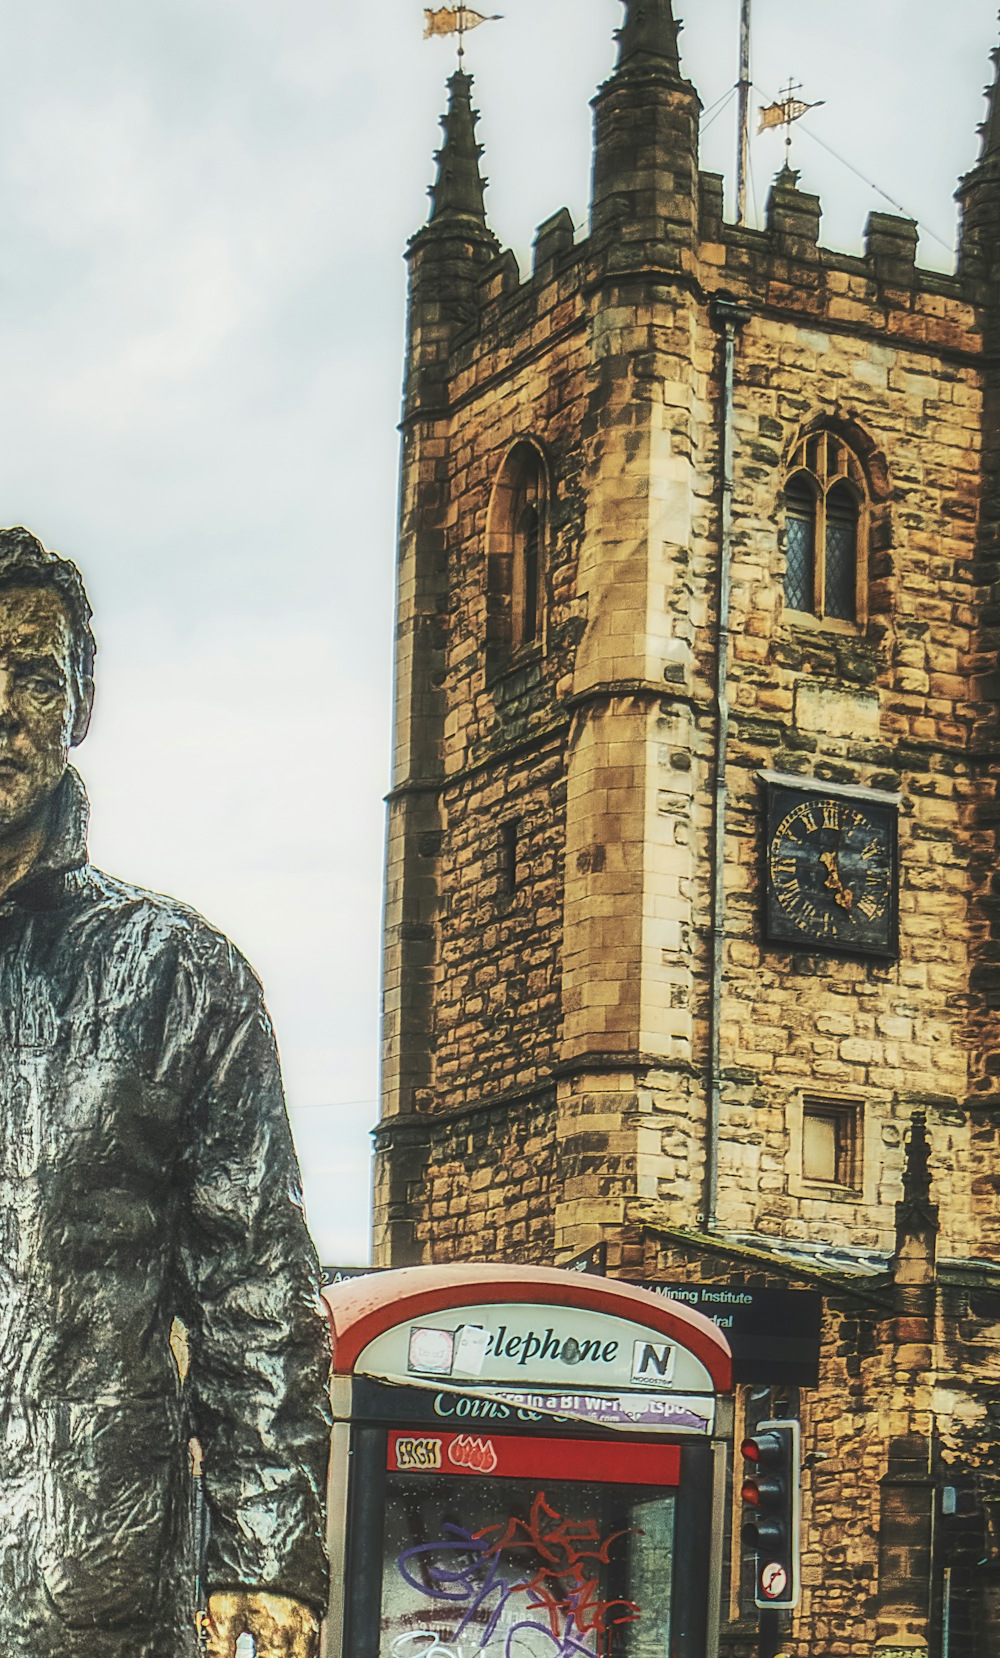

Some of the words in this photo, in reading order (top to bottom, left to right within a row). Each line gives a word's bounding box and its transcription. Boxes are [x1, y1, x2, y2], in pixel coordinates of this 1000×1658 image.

[655, 1286, 699, 1304] Mining
[701, 1289, 753, 1305] Institute
[545, 1396, 557, 1409] a
